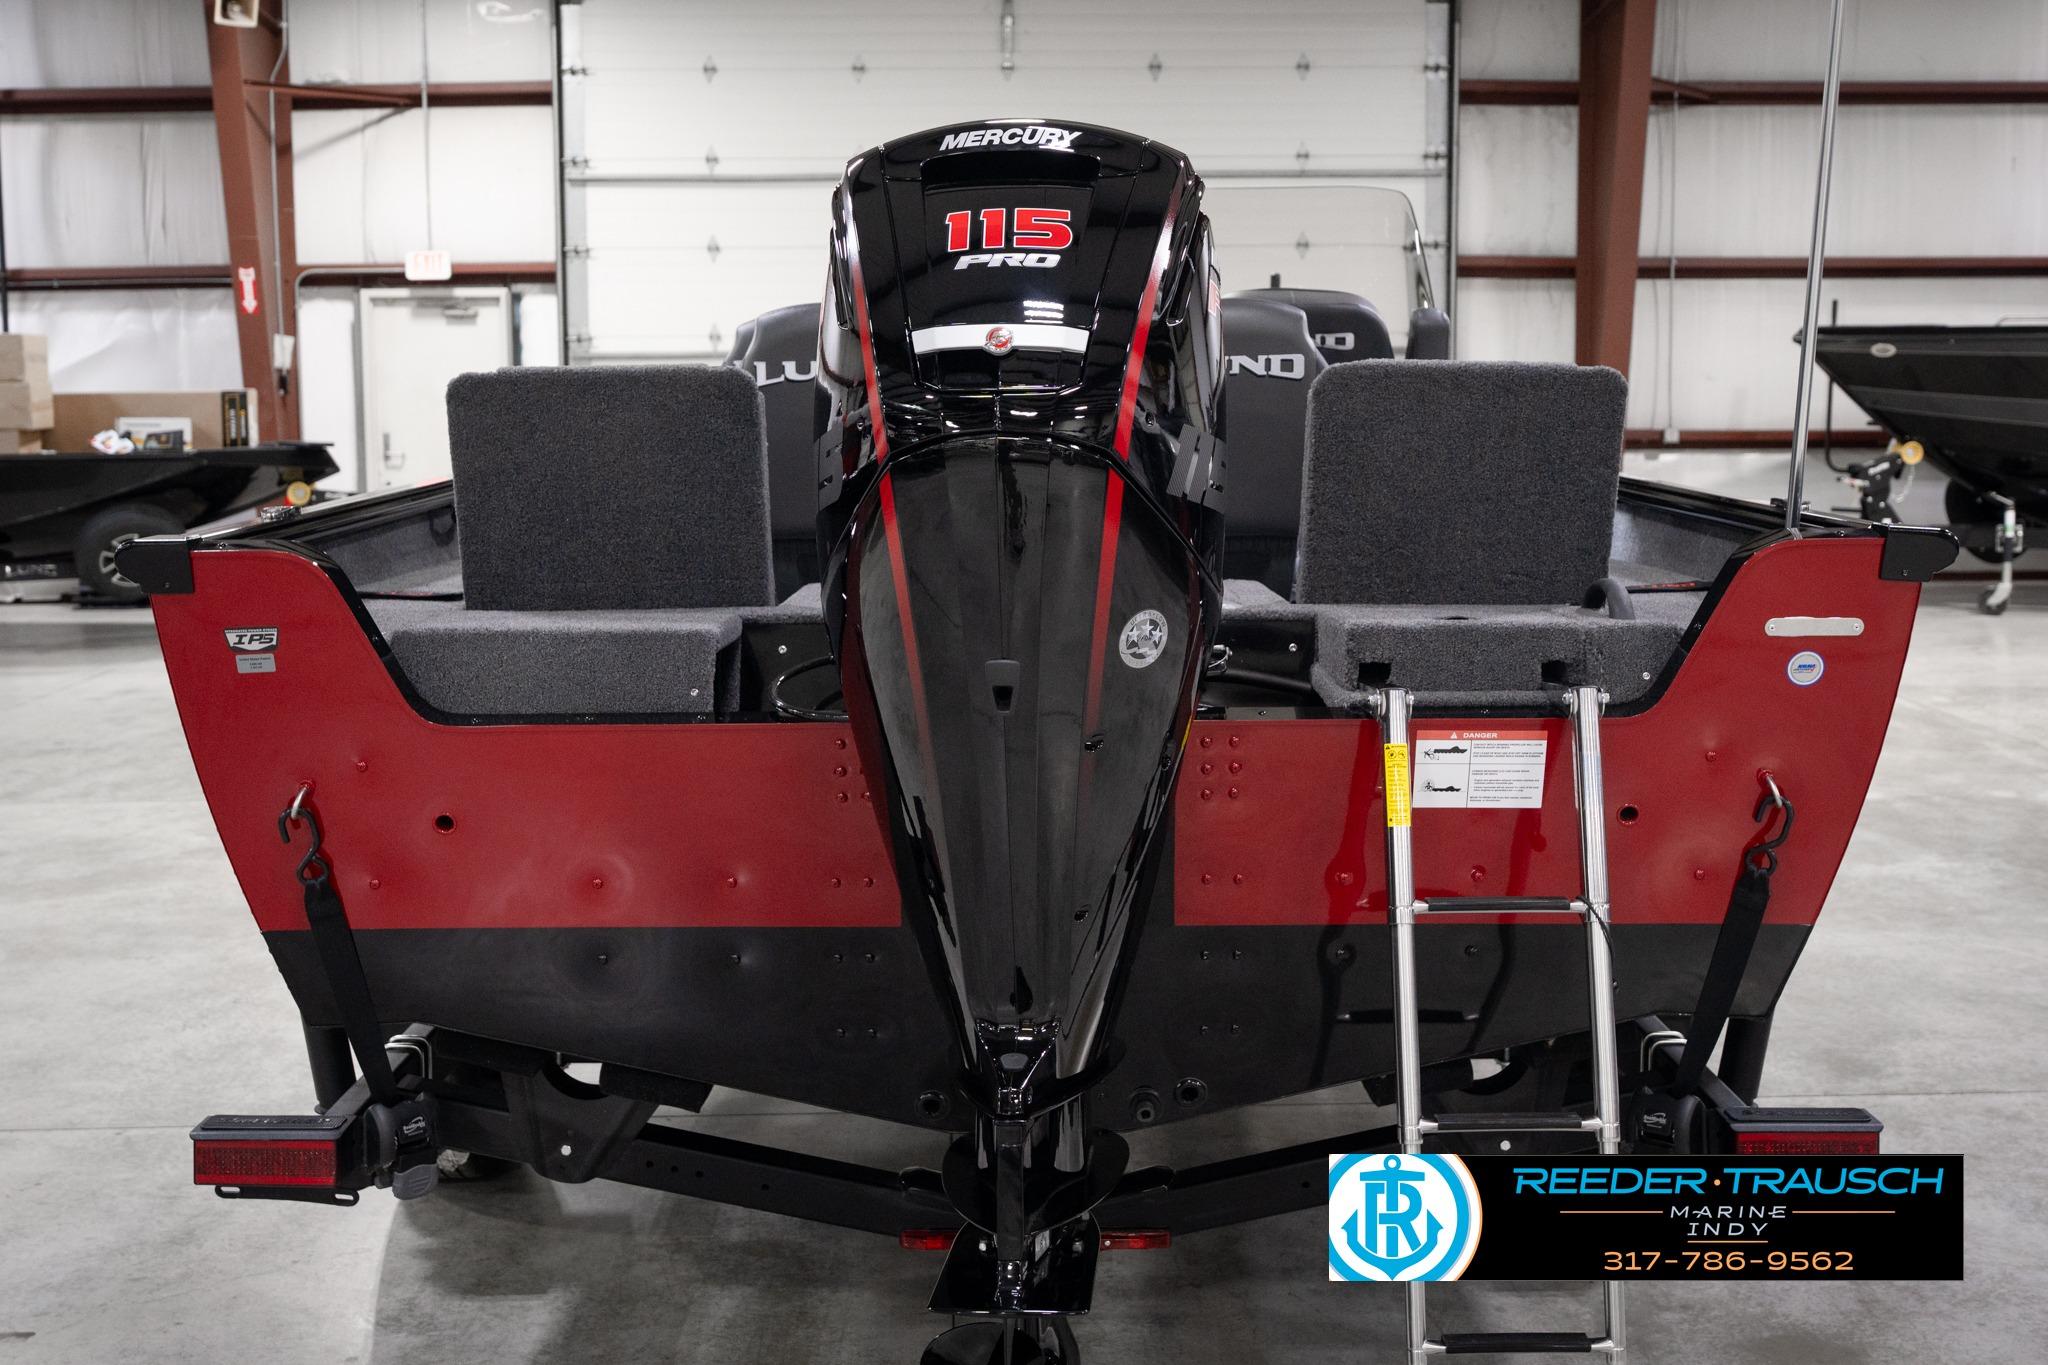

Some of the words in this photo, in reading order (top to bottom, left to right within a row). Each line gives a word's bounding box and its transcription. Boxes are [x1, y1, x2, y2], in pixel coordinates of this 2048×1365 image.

[939, 126, 1083, 151] MERCURY
[945, 207, 1073, 252] 115
[954, 253, 1061, 270] PRO
[753, 360, 817, 387] LU
[1226, 353, 1306, 380] ND
[233, 633, 275, 646] IPS
